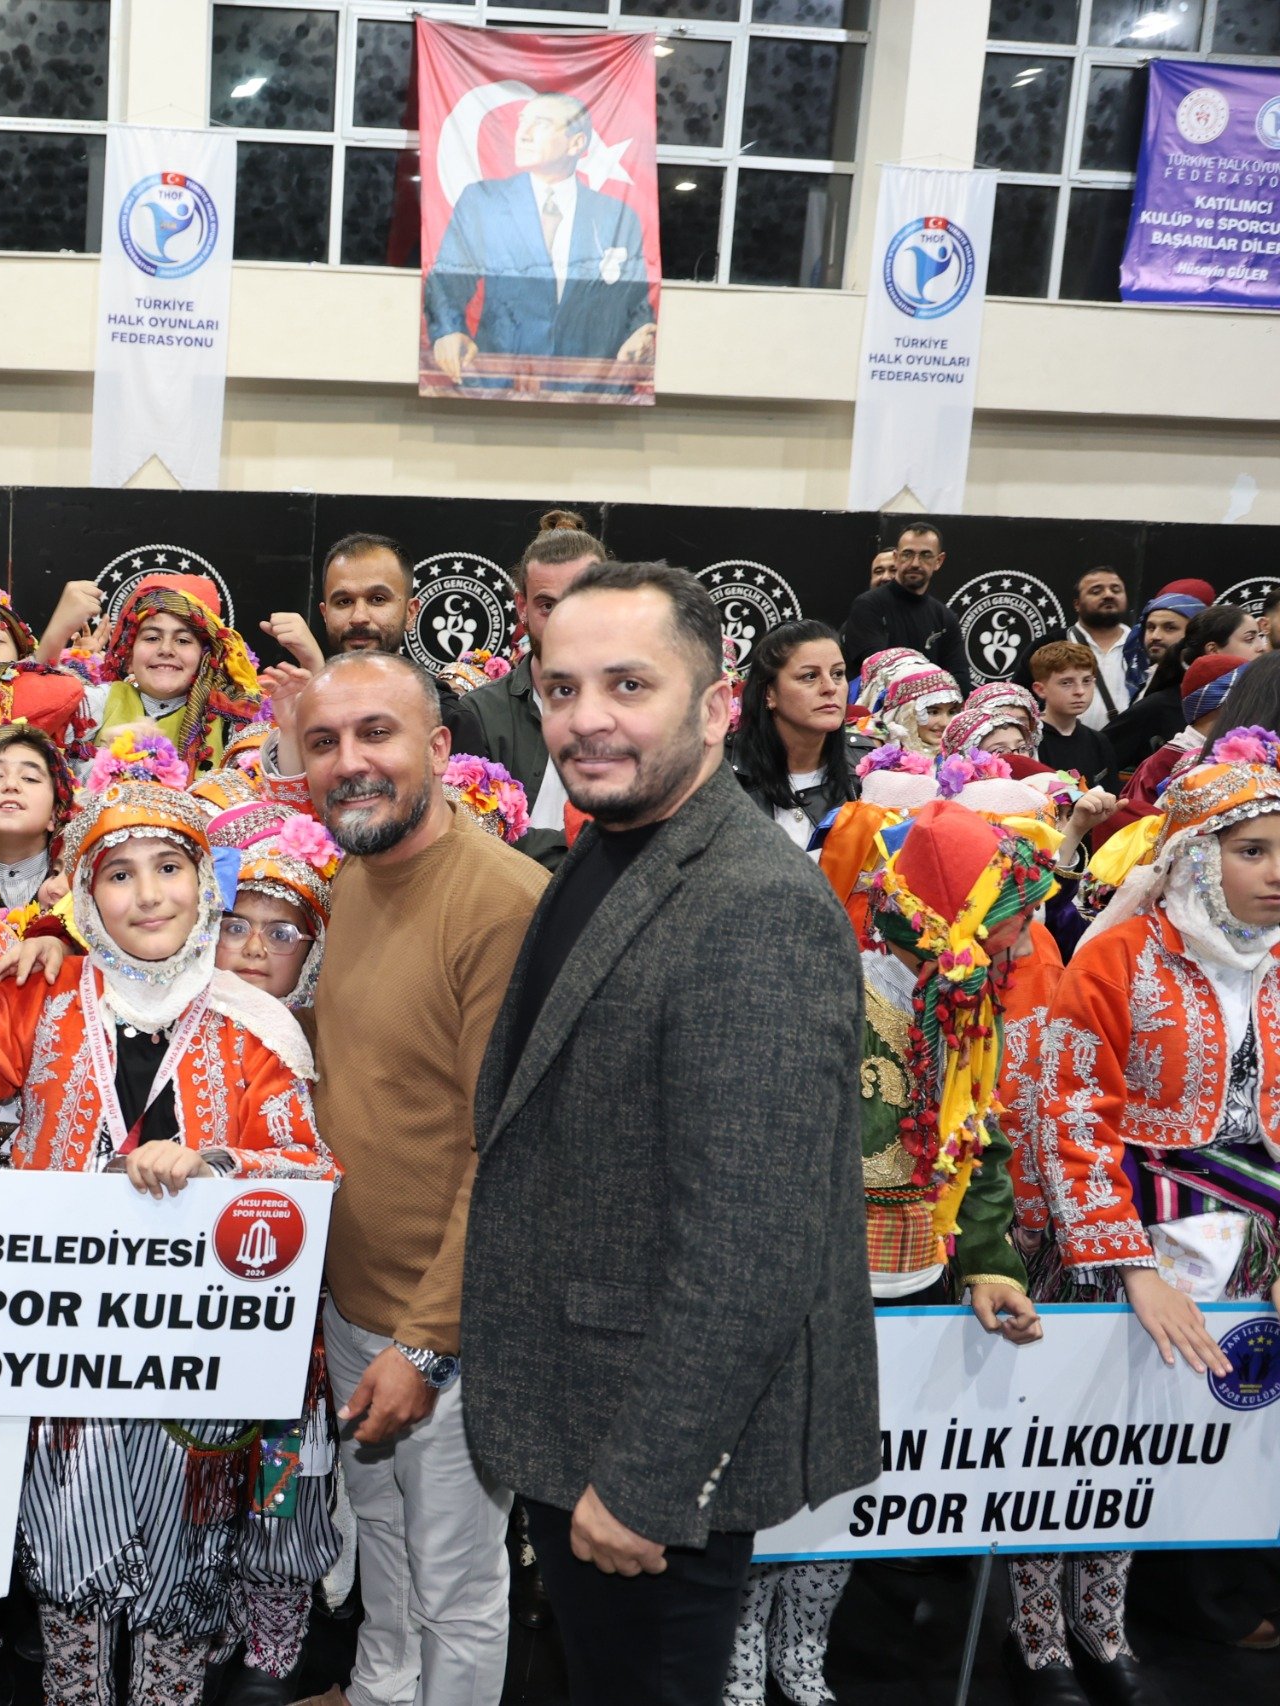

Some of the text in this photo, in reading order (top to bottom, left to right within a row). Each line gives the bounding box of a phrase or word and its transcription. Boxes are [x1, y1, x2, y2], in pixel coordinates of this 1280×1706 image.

[1168, 153, 1280, 174] TÜRKİYE HALK OYUN
[1164, 167, 1280, 188] FEDERASYO
[158, 190, 183, 200] THOF
[1194, 196, 1274, 214] KATILIMCI
[1140, 210, 1280, 235] KULÜP ve SPORCU
[1151, 231, 1280, 255] BAŞARILAR DİLE
[1177, 262, 1269, 281] Hüseyin GÜLER
[135, 296, 194, 312] TÜRKİYE
[108, 314, 219, 331] HALK OYUNLARI
[111, 331, 214, 348] FEDERASYONU
[894, 336, 948, 350] TÜRKİYE
[869, 353, 970, 368] HALK OYUNLARI
[871, 369, 965, 384] FEDERASYONU
[443, 579, 484, 595] GENÇLİK
[481, 592, 494, 607] VE
[489, 604, 501, 630] SPOR
[724, 587, 763, 602] GENÇLİK
[761, 599, 772, 613] VE
[992, 597, 1028, 611] GENÇLİK
[1027, 607, 1036, 620] VE
[1033, 619, 1043, 638] SPO
[232, 1209, 291, 1218] SPOR KULÜBÜ
[237, 1199, 289, 1208] AKSU PERGE
[98, 1285, 296, 1332] KULÜBÜ
[1219, 1382, 1241, 1403] SPOR
[881, 1415, 1232, 1472] AN İLK İLKOKULU
[849, 1478, 1155, 1537] SPOR KULÜBÜ
